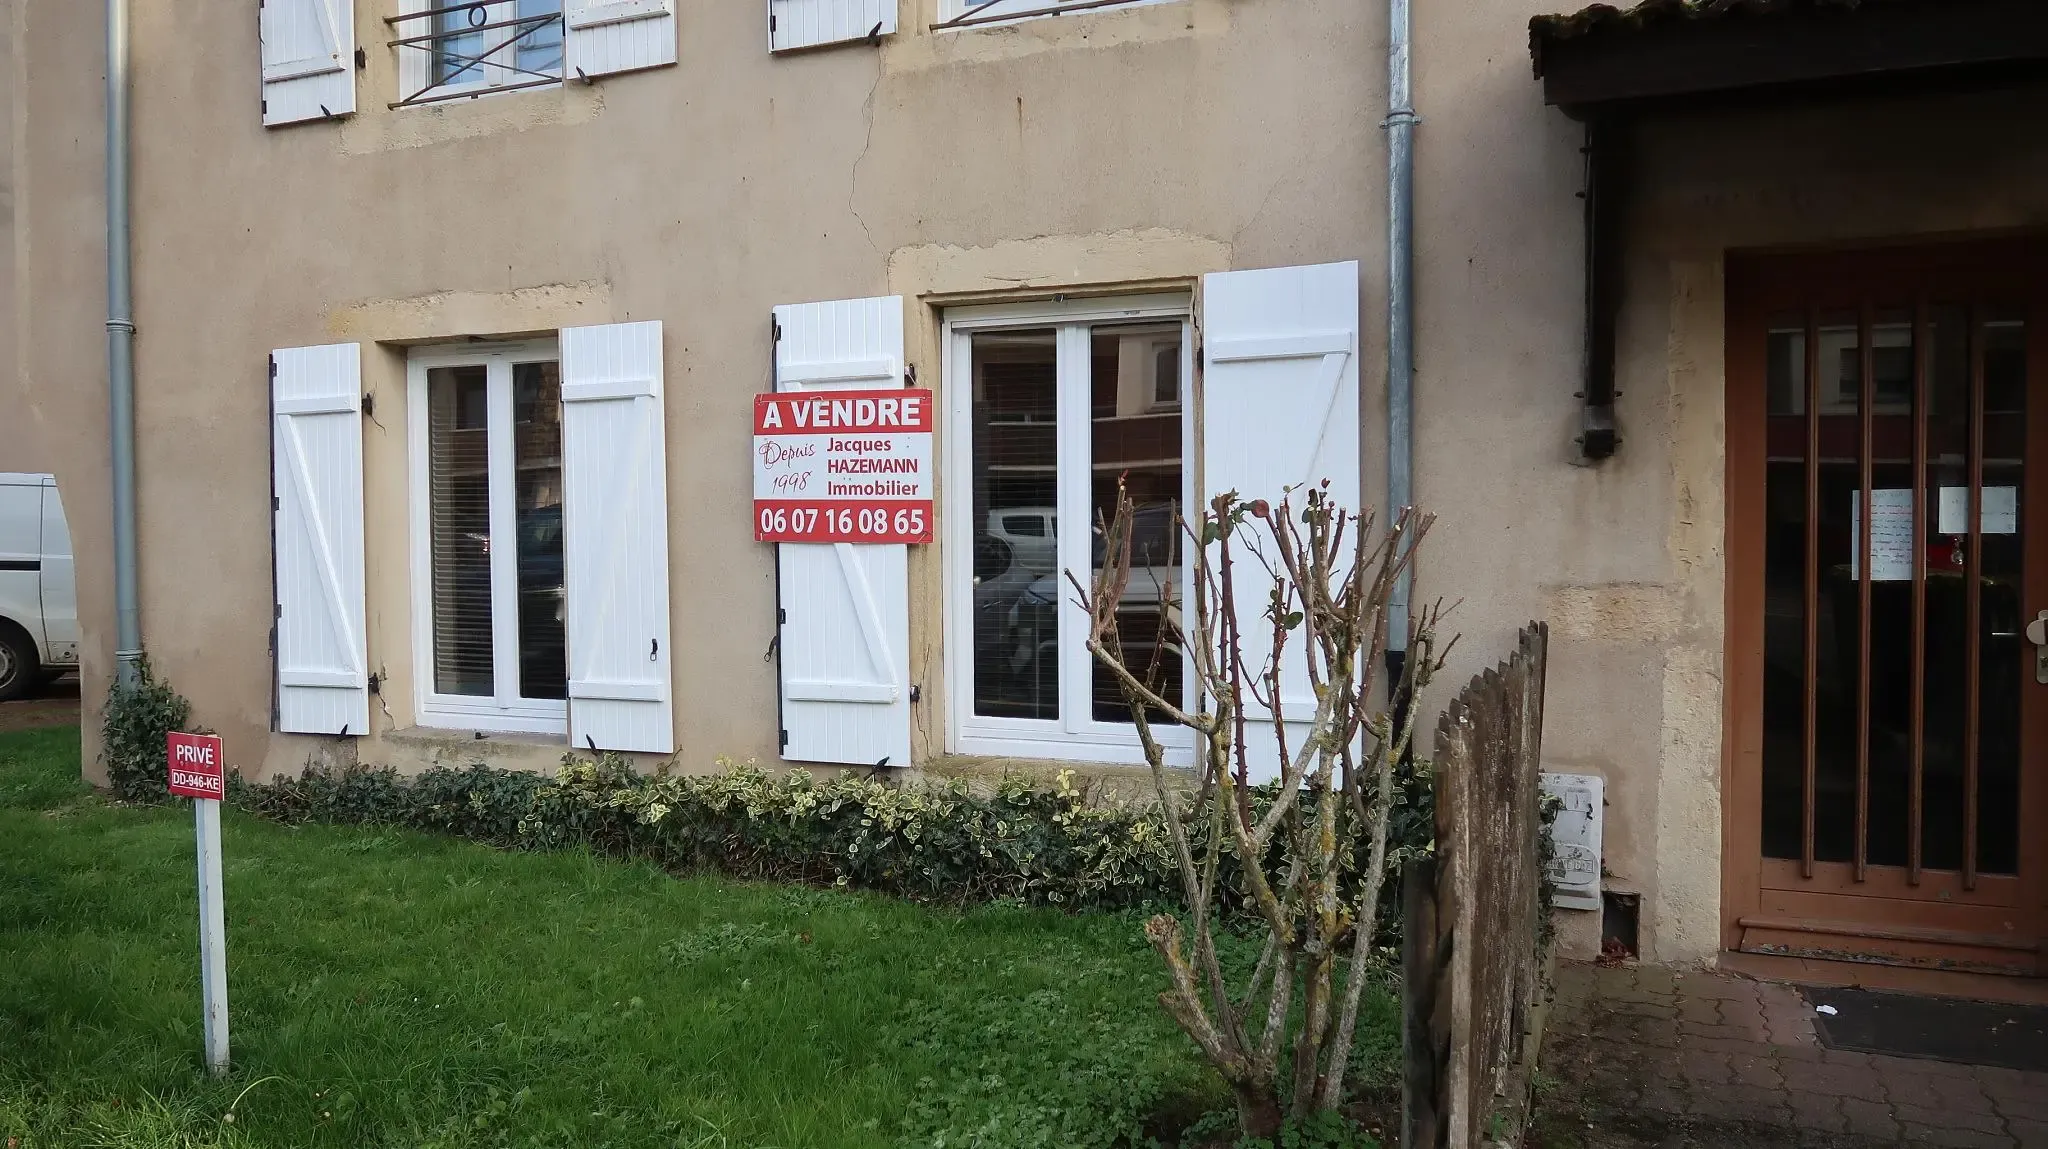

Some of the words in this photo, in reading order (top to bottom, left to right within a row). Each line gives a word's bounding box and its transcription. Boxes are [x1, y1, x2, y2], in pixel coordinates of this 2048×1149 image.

[762, 401, 783, 429] A
[790, 398, 921, 428] VENDRE
[758, 440, 816, 470] Depuis
[827, 437, 892, 456] Jacques
[827, 458, 918, 474] HAZEMANN
[772, 471, 813, 494] 1998
[827, 480, 919, 496] Immobilier
[760, 508, 787, 533] 06
[791, 508, 818, 534] 07
[825, 508, 853, 534] 16
[858, 508, 888, 535] 08
[894, 508, 924, 535] 65
[176, 743, 214, 765] PRIVÉ
[173, 772, 219, 790] DD-946-KE
